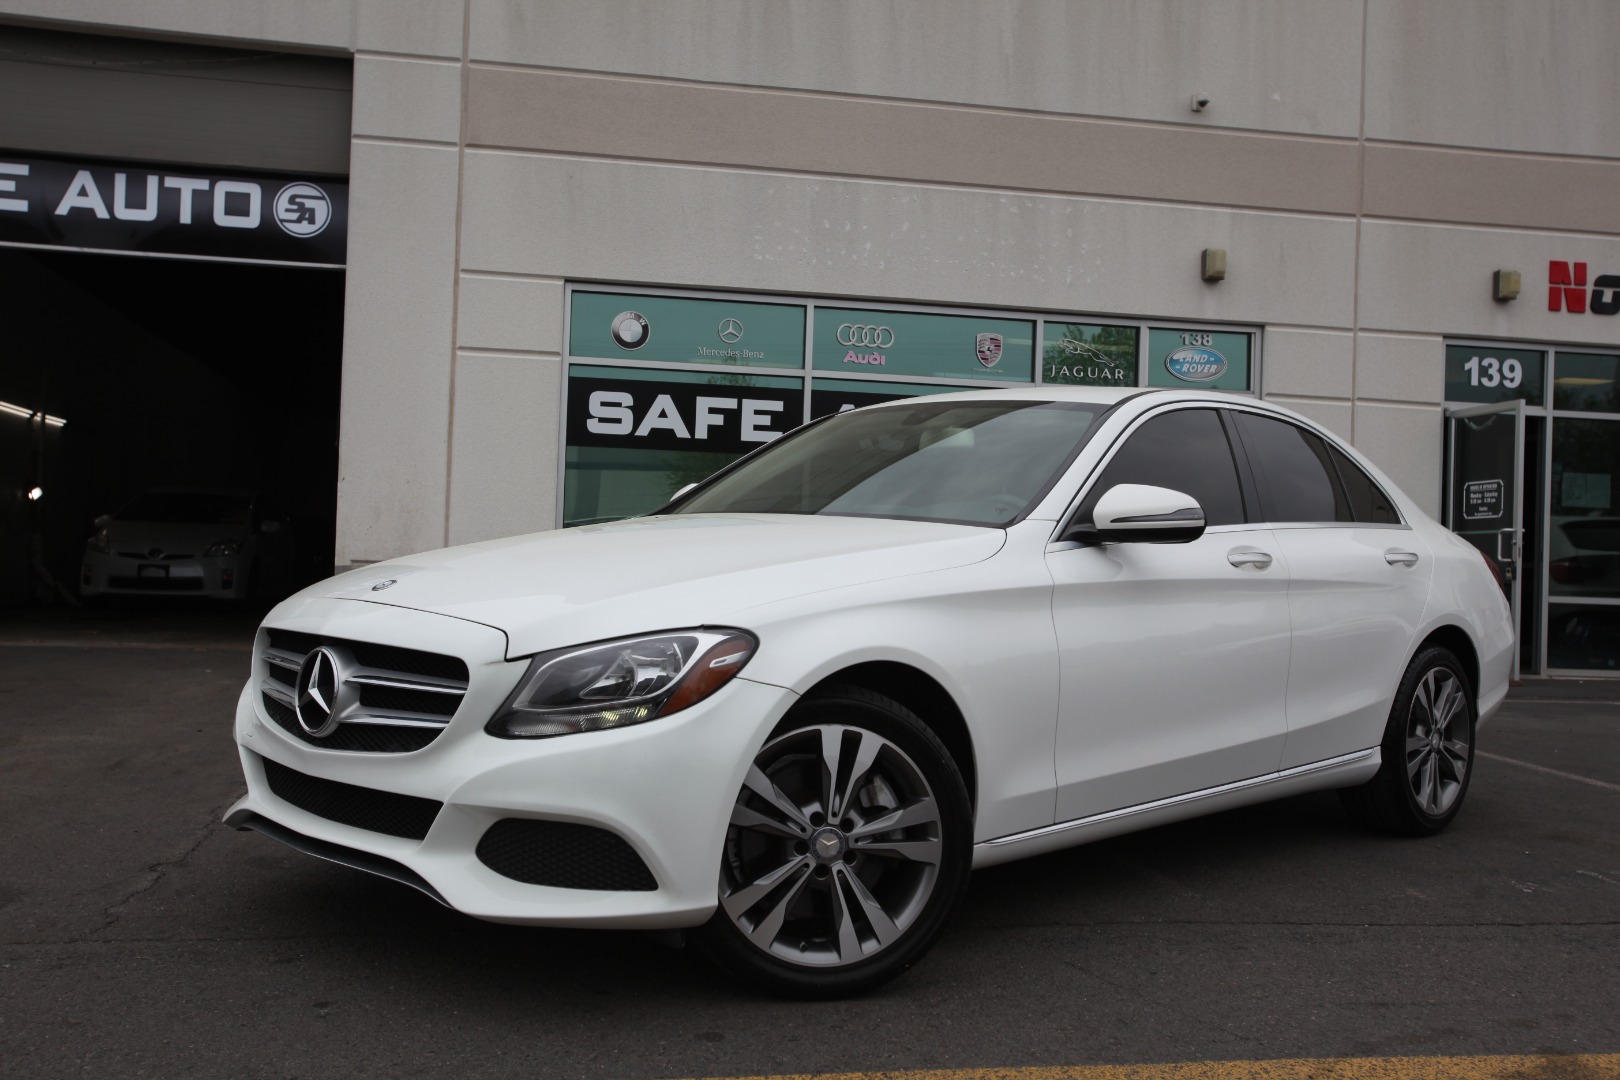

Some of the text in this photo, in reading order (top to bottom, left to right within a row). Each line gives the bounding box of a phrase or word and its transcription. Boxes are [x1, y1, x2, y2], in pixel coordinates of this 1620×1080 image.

[54, 170, 262, 229] AUTO
[1181, 332, 1213, 346] 138
[697, 346, 765, 359] Mercedes-Benz
[843, 350, 886, 365] Audi
[1050, 364, 1124, 380] JAGUAR
[1182, 363, 1217, 373] ROVER
[1464, 356, 1522, 388] 139
[586, 390, 784, 442] SAFE
